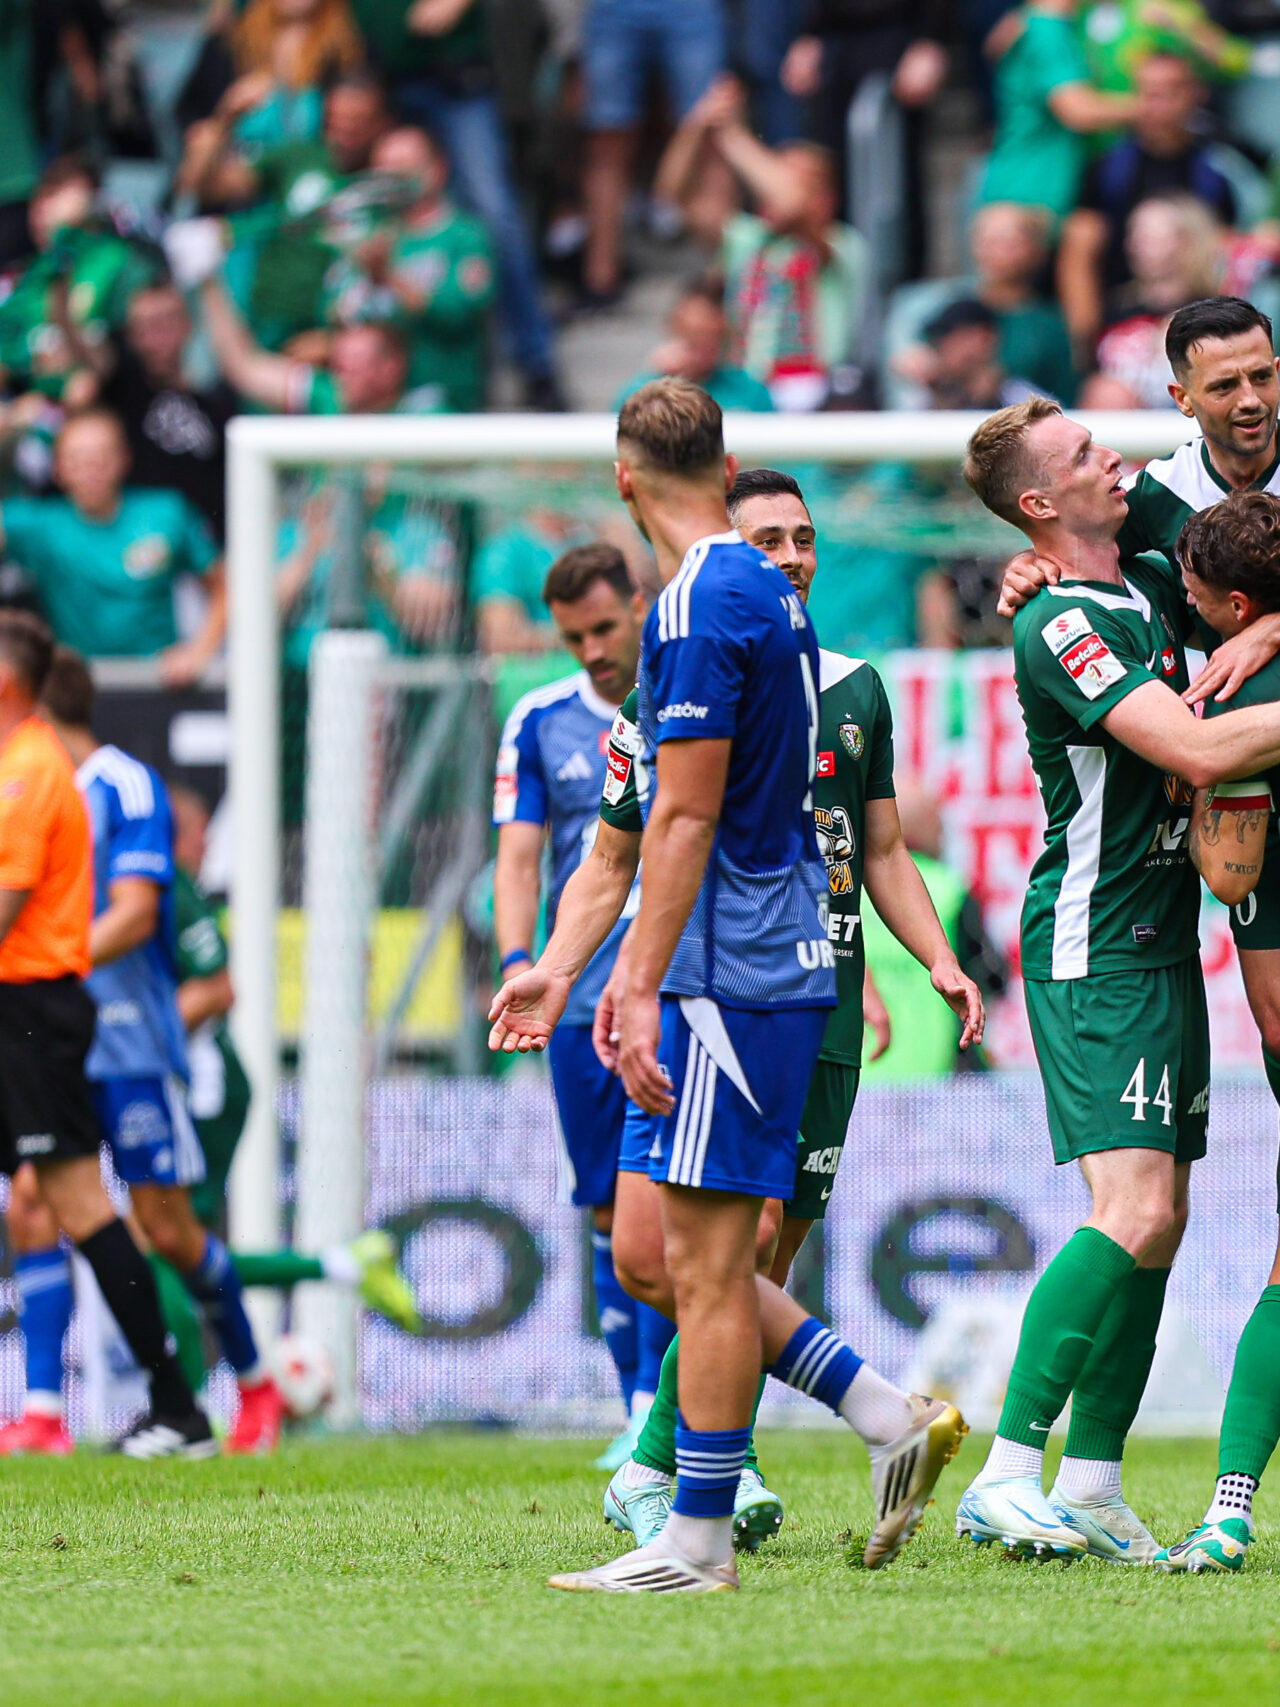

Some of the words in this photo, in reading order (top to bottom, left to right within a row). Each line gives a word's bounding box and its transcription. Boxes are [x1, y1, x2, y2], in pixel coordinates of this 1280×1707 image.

[1055, 626, 1085, 649] SUZUKI
[1066, 641, 1102, 671] Betclic
[1120, 1057, 1173, 1127] 44
